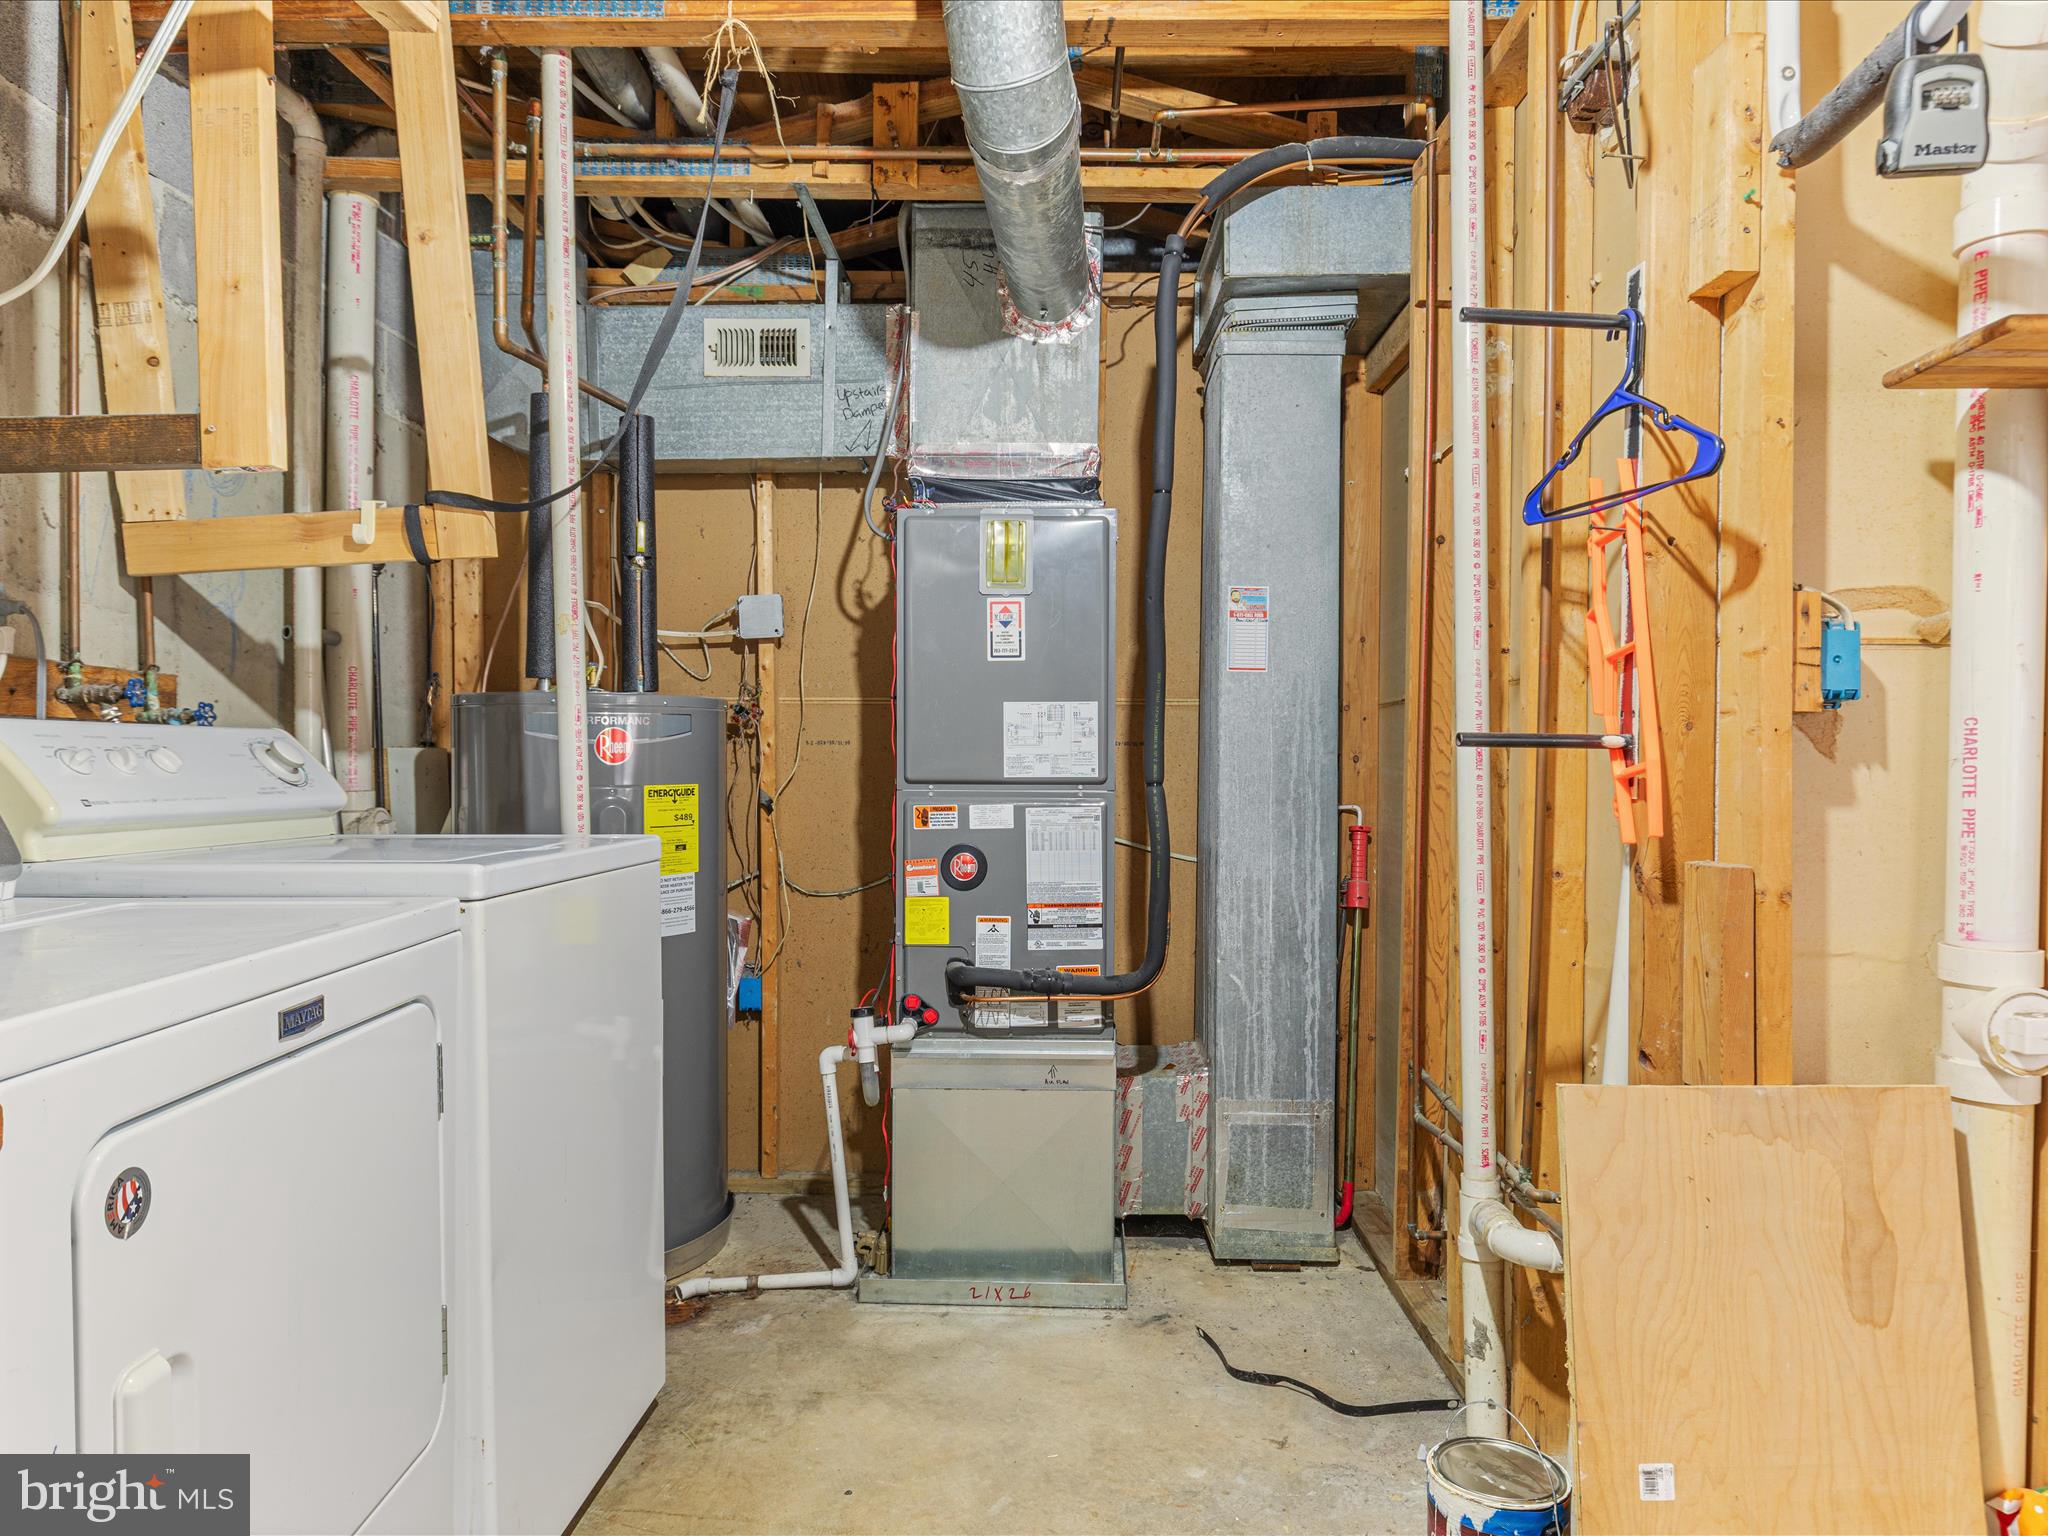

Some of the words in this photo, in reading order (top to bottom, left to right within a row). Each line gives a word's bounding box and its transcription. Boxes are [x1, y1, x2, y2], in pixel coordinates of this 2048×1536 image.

[1469, 8, 1477, 37] CHARLOTTE
[1469, 40, 1477, 52] PIPE
[1914, 143, 1977, 157] Master
[1470, 181, 1478, 195] ASTM
[1972, 268, 1988, 304] PIPE
[348, 375, 359, 419] CHARLOTTE
[348, 425, 358, 441] PIPE
[1472, 416, 1480, 444] CHARLOTTE
[1472, 448, 1480, 459] PIPE
[1473, 590, 1481, 603] ASTM
[347, 666, 358, 711] CHARLOTTE
[347, 715, 357, 733] PIPE
[588, 716, 650, 725] RFORMANC
[1475, 724, 1483, 733] TYP
[1475, 748, 1483, 771] CHEDULE
[1962, 717, 1978, 798] CHARLOTTE
[648, 788, 695, 798] ENERGYGUIDE
[674, 813, 693, 821] $489
[1961, 808, 1977, 839] PIPE
[1477, 822, 1485, 851] CHARLOTTE
[1477, 854, 1485, 865] PIPE
[661, 905, 694, 914] -866-279-4566
[1479, 994, 1487, 1008] ASTM
[284, 1003, 323, 1031] MAYTAG
[104, 1177, 124, 1234] AMERICA
